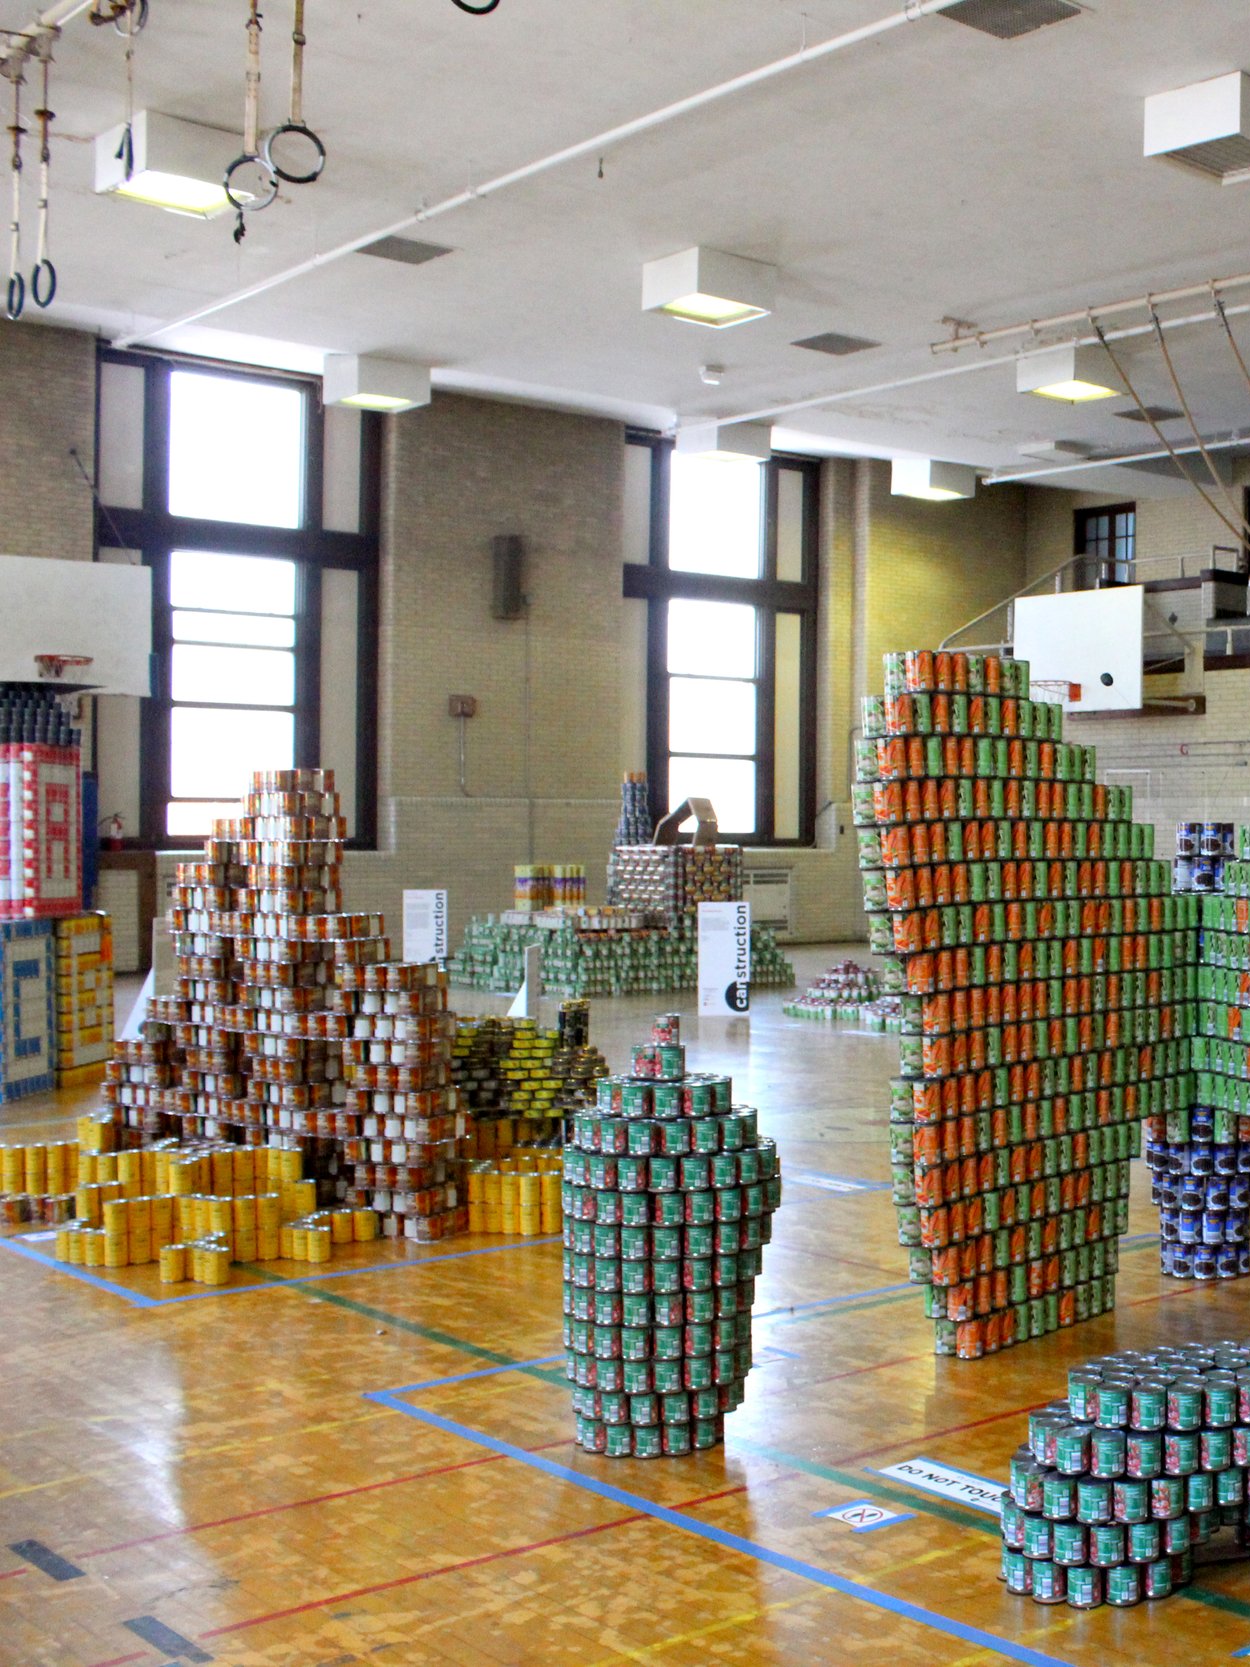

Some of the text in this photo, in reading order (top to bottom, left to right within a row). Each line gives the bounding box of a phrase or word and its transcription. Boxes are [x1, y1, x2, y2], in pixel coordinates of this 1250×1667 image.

[733, 904, 748, 1009] canstruction
[897, 1464, 924, 1475] DO
[921, 1473, 957, 1486] NOT
[960, 1484, 1001, 1502] TOUC
